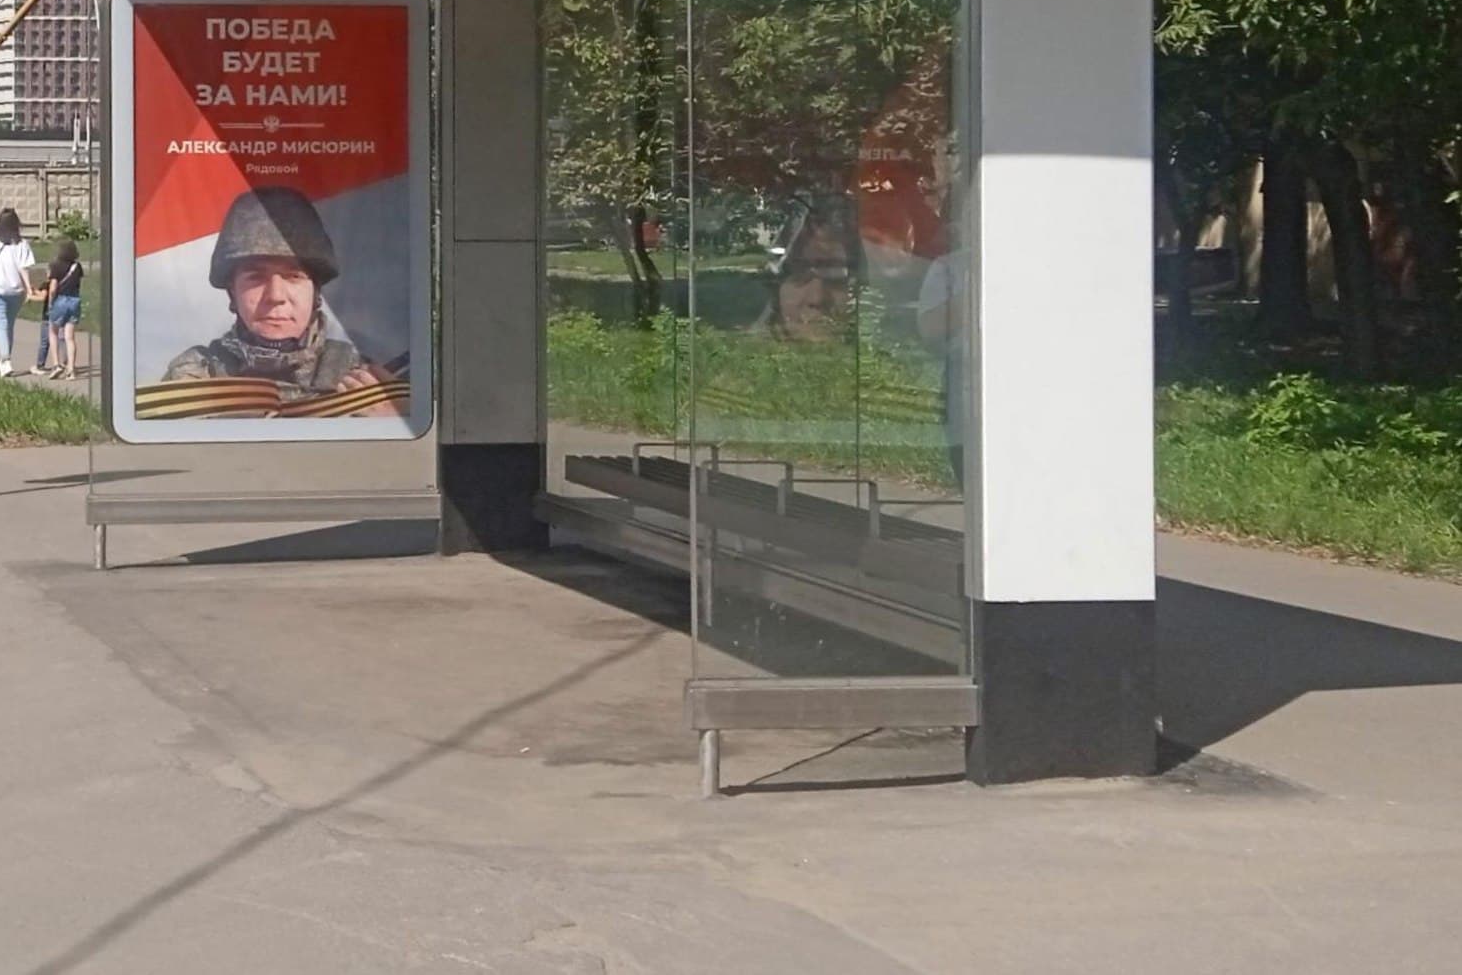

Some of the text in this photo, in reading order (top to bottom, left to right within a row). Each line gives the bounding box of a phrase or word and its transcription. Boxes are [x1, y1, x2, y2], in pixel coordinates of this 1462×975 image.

[206, 18, 336, 43] ПОБЕДА
[222, 51, 321, 76] БУДЕТ
[195, 83, 347, 106] ЗА НАМИ!
[167, 141, 376, 155] АЛЕКСАНДР МИСЮРИН
[245, 163, 299, 175] Рядовой
